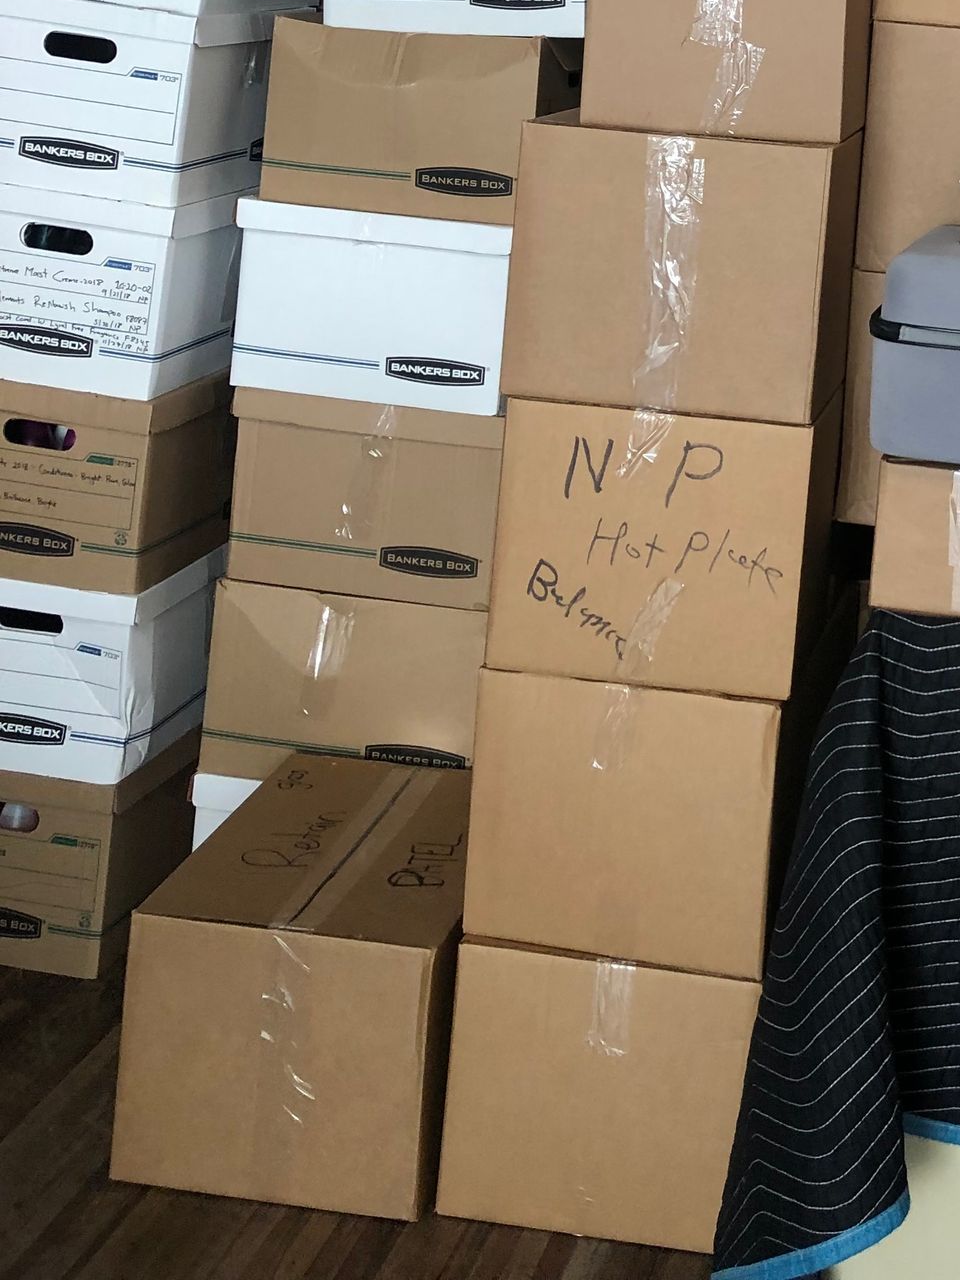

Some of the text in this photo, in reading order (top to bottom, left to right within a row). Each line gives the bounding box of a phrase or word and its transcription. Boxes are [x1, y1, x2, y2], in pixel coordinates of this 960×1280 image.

[24, 142, 114, 164] BANKERS BOX
[421, 174, 505, 190] BANKERS BOX
[0, 329, 88, 352] BANKERS BOX
[391, 362, 480, 381] BANKERS BOX
[564, 435, 723, 509] N P
[42, 538, 68, 550] BOX
[586, 517, 664, 569] Hot
[386, 553, 471, 572] BANKERS BOX
[33, 726, 61, 739] BOX
[371, 751, 459, 769] BANKERS BOX
[10, 920, 36, 933] BOX
